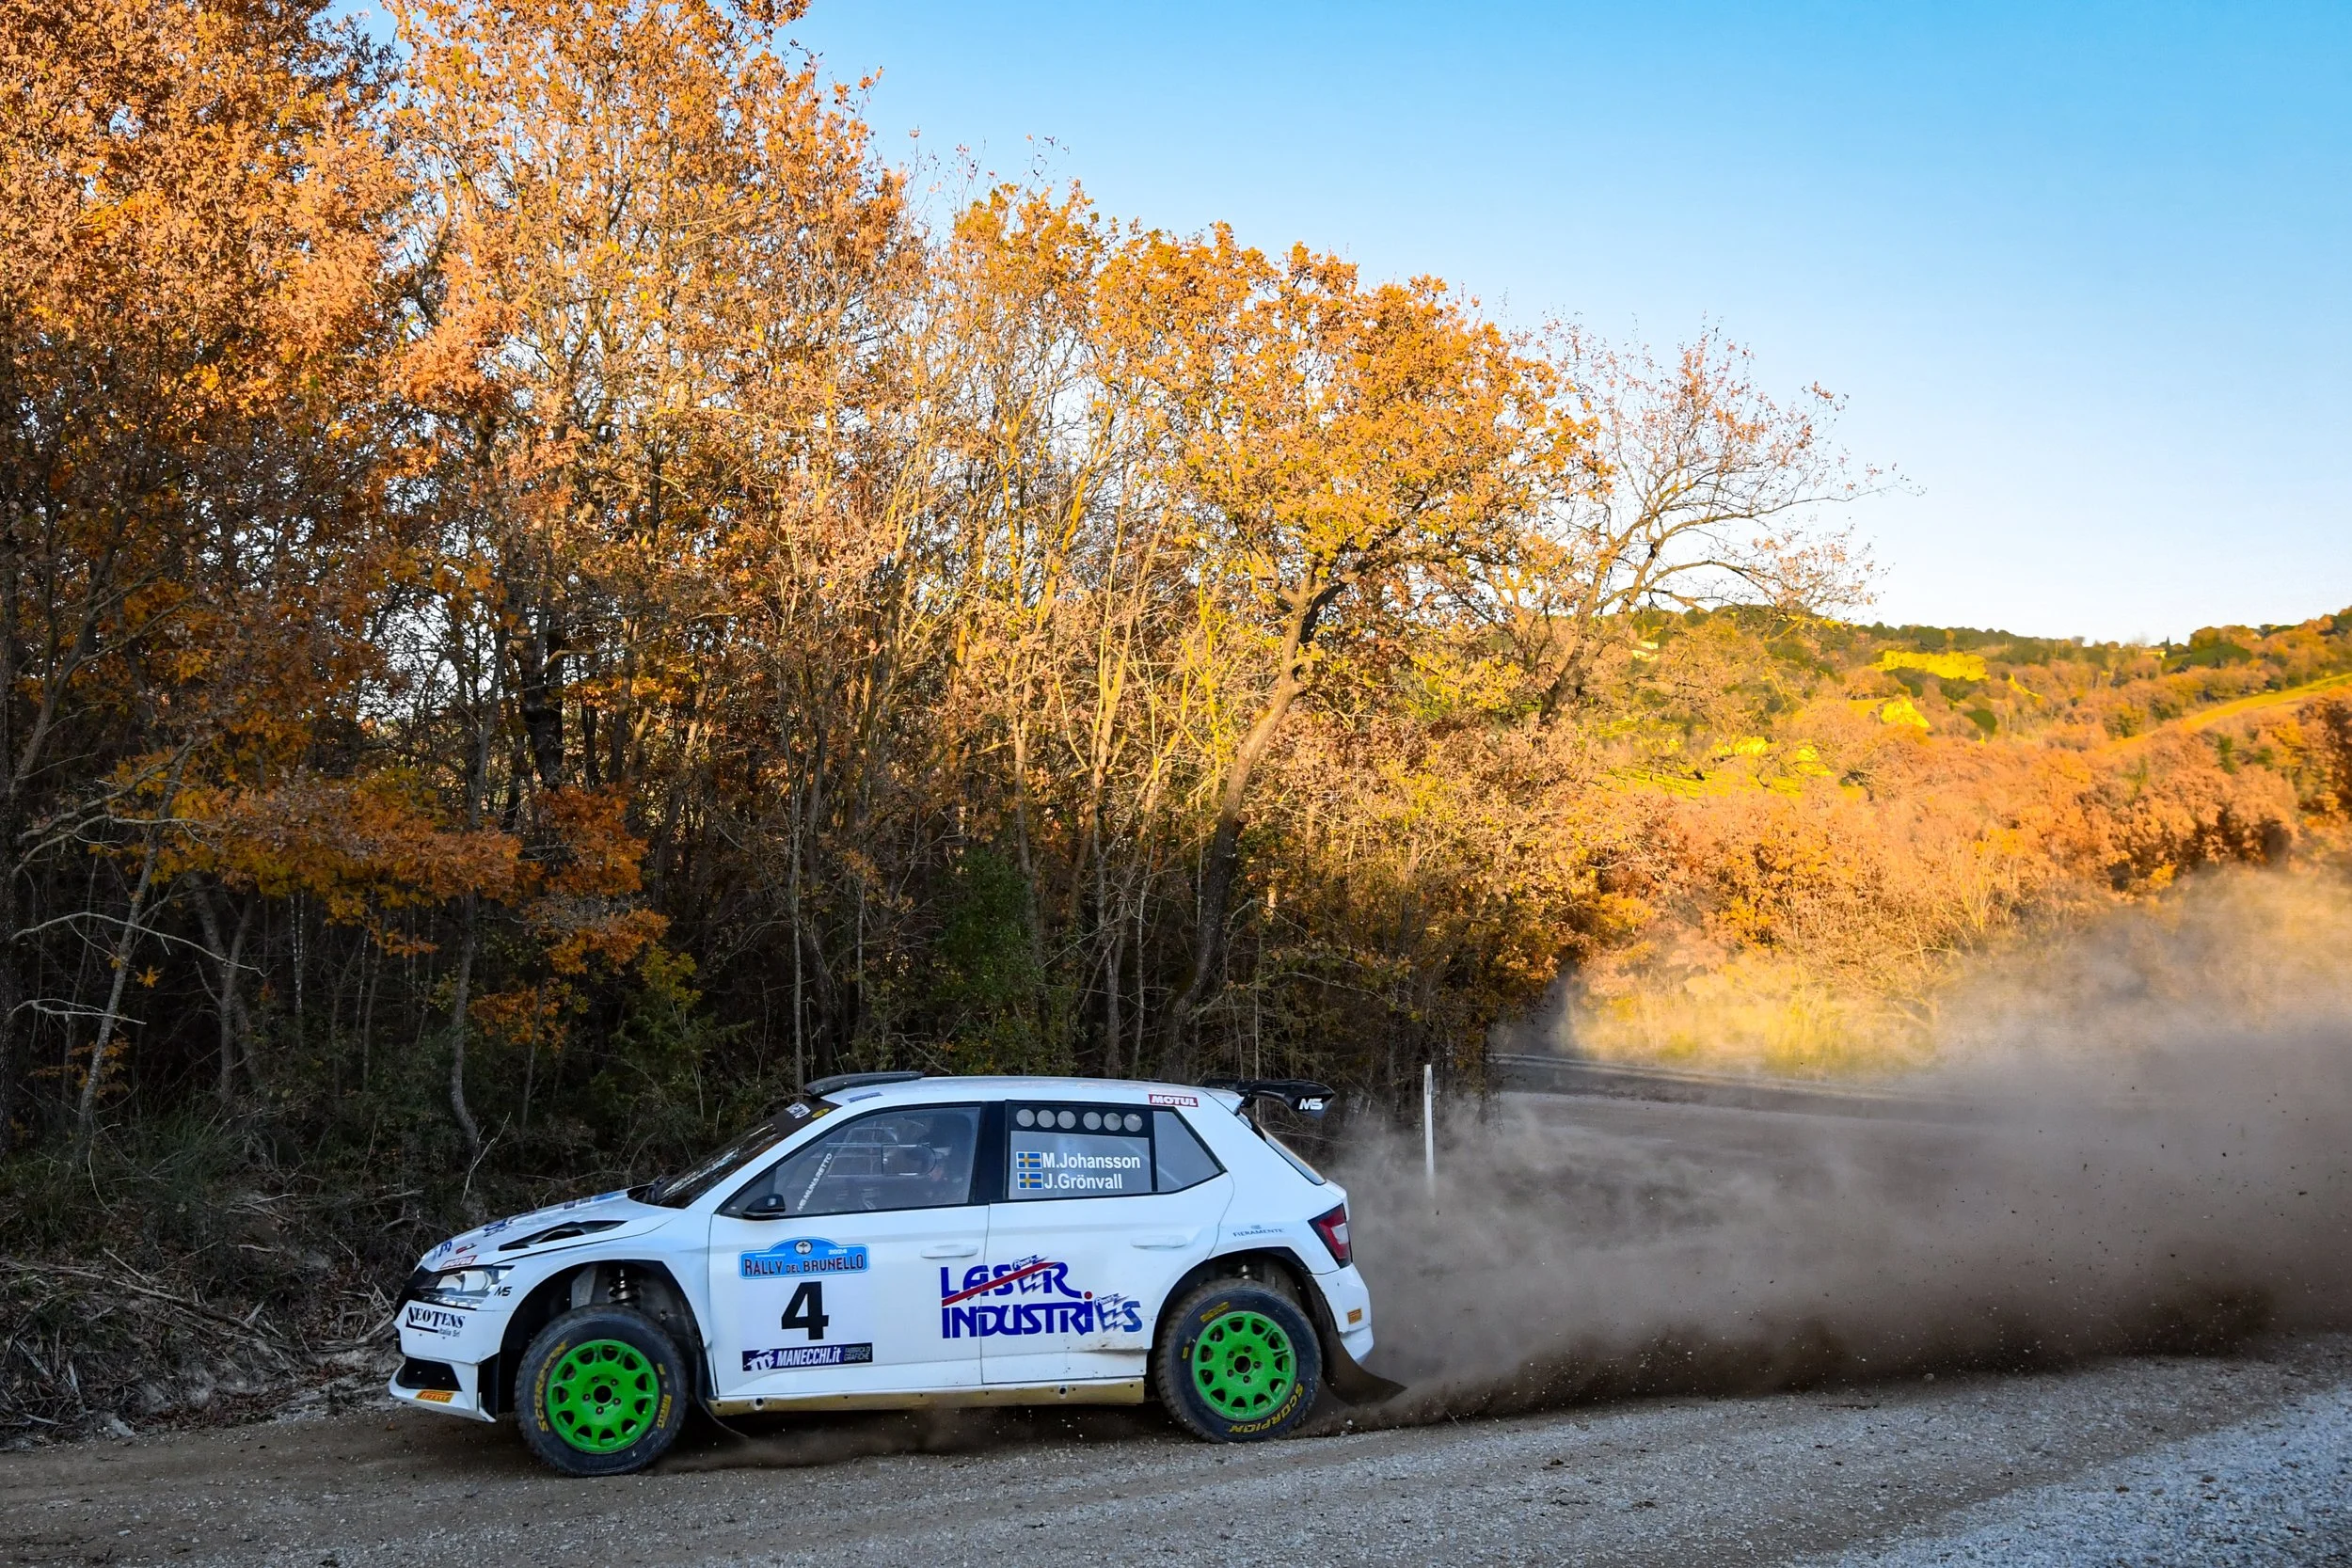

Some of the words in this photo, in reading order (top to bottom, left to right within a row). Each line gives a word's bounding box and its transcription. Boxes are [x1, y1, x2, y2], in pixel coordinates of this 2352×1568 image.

[1151, 1095, 1197, 1106] MOTUL
[1298, 1098, 1324, 1110] MS
[1042, 1152, 1140, 1169] M.Johansson
[803, 1153, 833, 1199] MUNARETTO
[1044, 1173, 1122, 1190] J.Grönvall
[744, 1259, 783, 1275] RALLY
[803, 1254, 864, 1272] BRUNELLO
[494, 1286, 513, 1297] MS
[406, 1307, 466, 1328] NEOTENS
[781, 1281, 829, 1340] 4
[776, 1346, 841, 1367] MANECCHI.it
[1229, 1384, 1303, 1433] SCORPION
